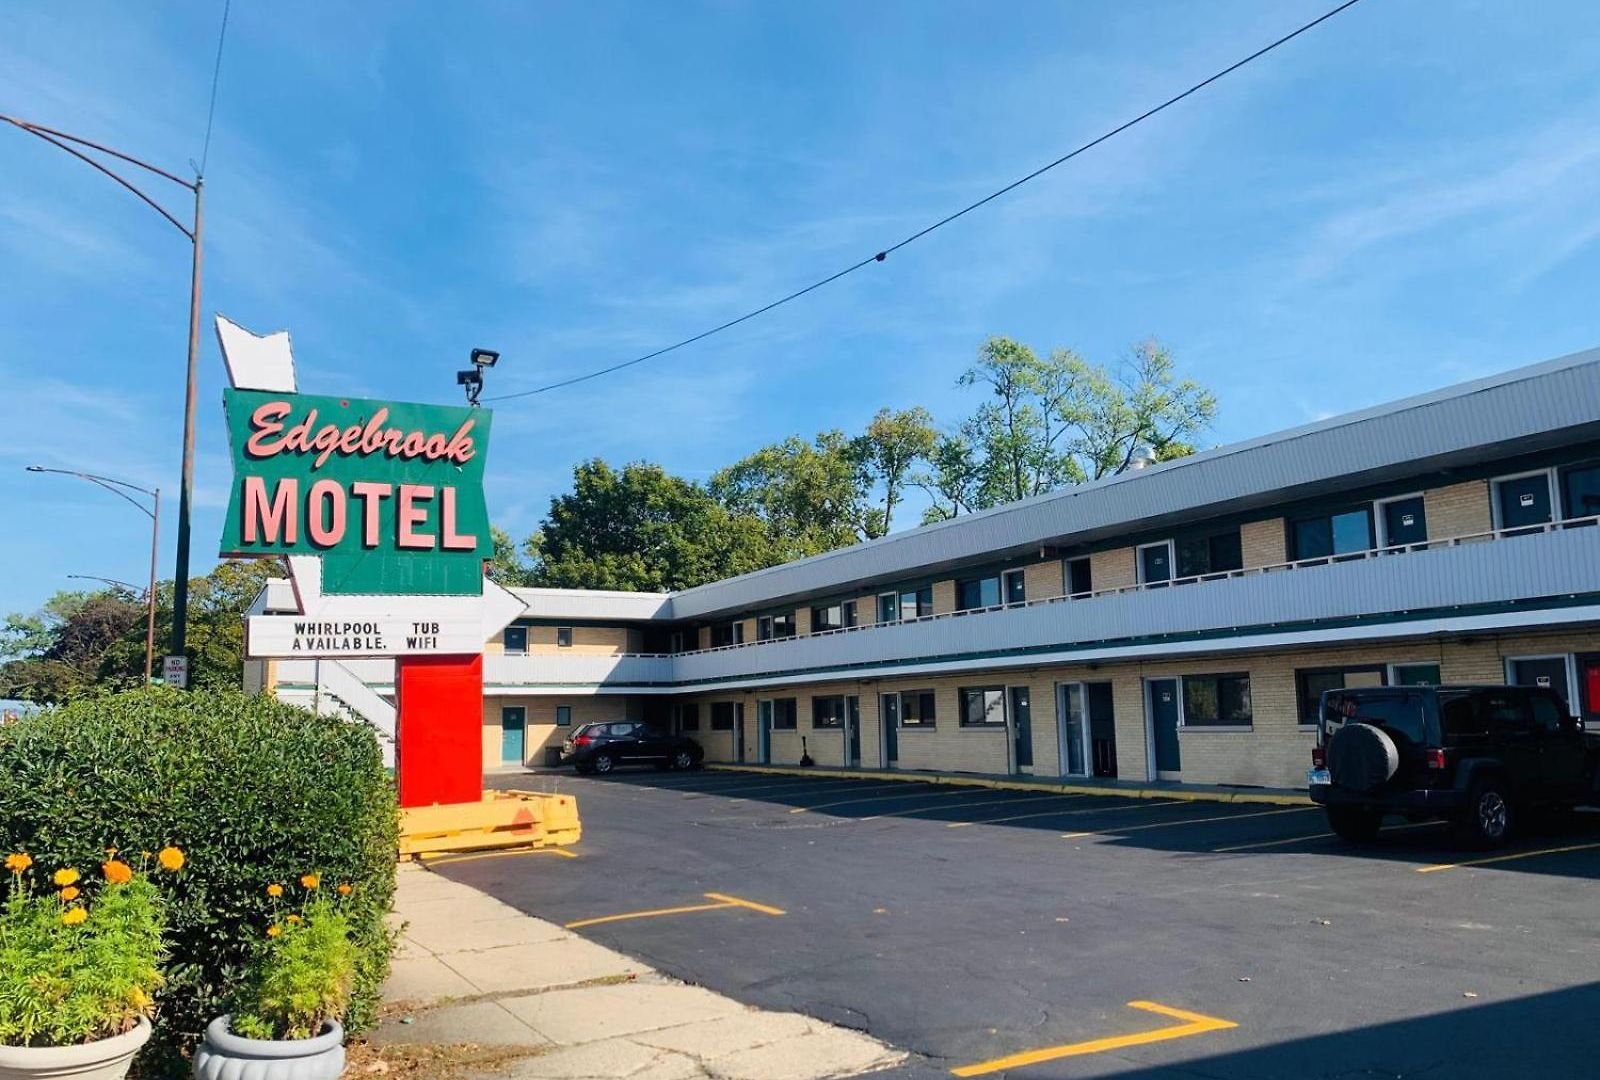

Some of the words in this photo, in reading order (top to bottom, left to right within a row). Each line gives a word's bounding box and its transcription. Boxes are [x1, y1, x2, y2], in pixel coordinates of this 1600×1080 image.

[248, 400, 476, 468] Edgebrook
[243, 475, 478, 549] MOTEL
[294, 622, 381, 635] WHIRLPOOL
[412, 622, 440, 635] TUB
[406, 637, 437, 649] WIFI
